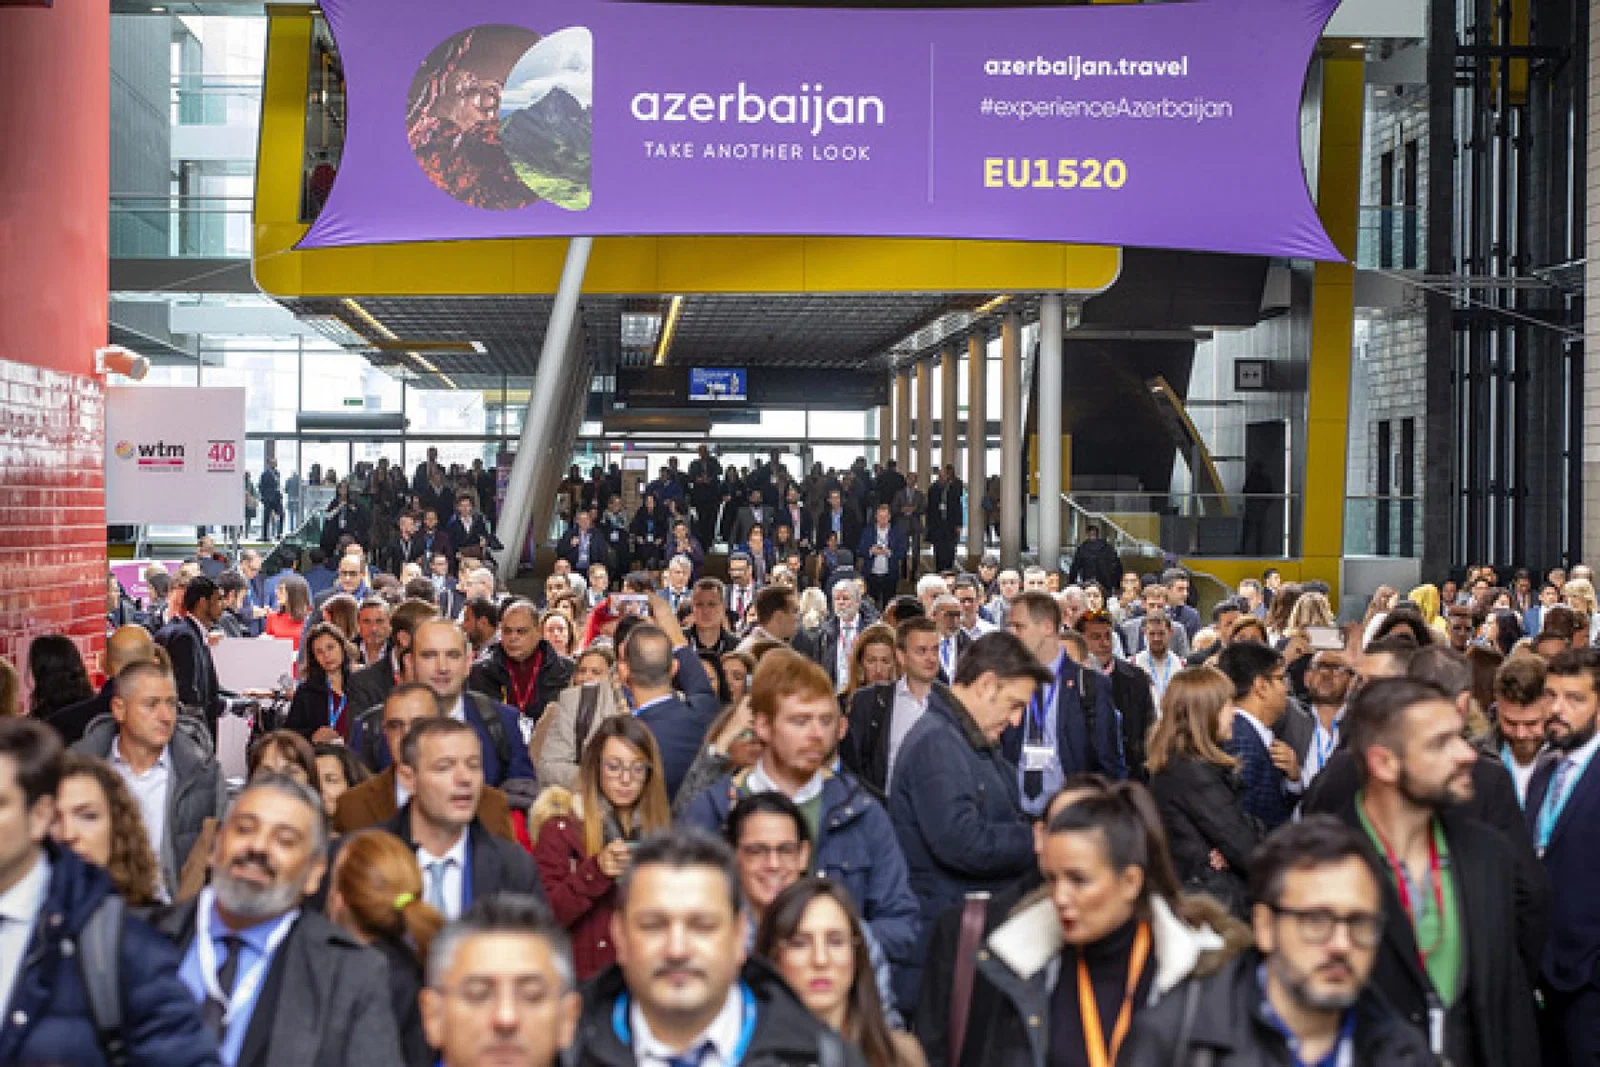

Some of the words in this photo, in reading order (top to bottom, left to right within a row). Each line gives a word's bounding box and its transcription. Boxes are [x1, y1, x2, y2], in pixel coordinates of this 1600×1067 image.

[983, 55, 1188, 81] azerbaijan.travel
[631, 82, 885, 136] azerbaijan
[980, 96, 1233, 123] #experienceAzerbaijan
[644, 141, 694, 158] TAKE
[703, 144, 803, 161] ANOTHER
[812, 145, 870, 161] LOOK
[984, 157, 1127, 189] EU1520
[138, 440, 185, 457] wtm
[207, 442, 235, 462] 40
